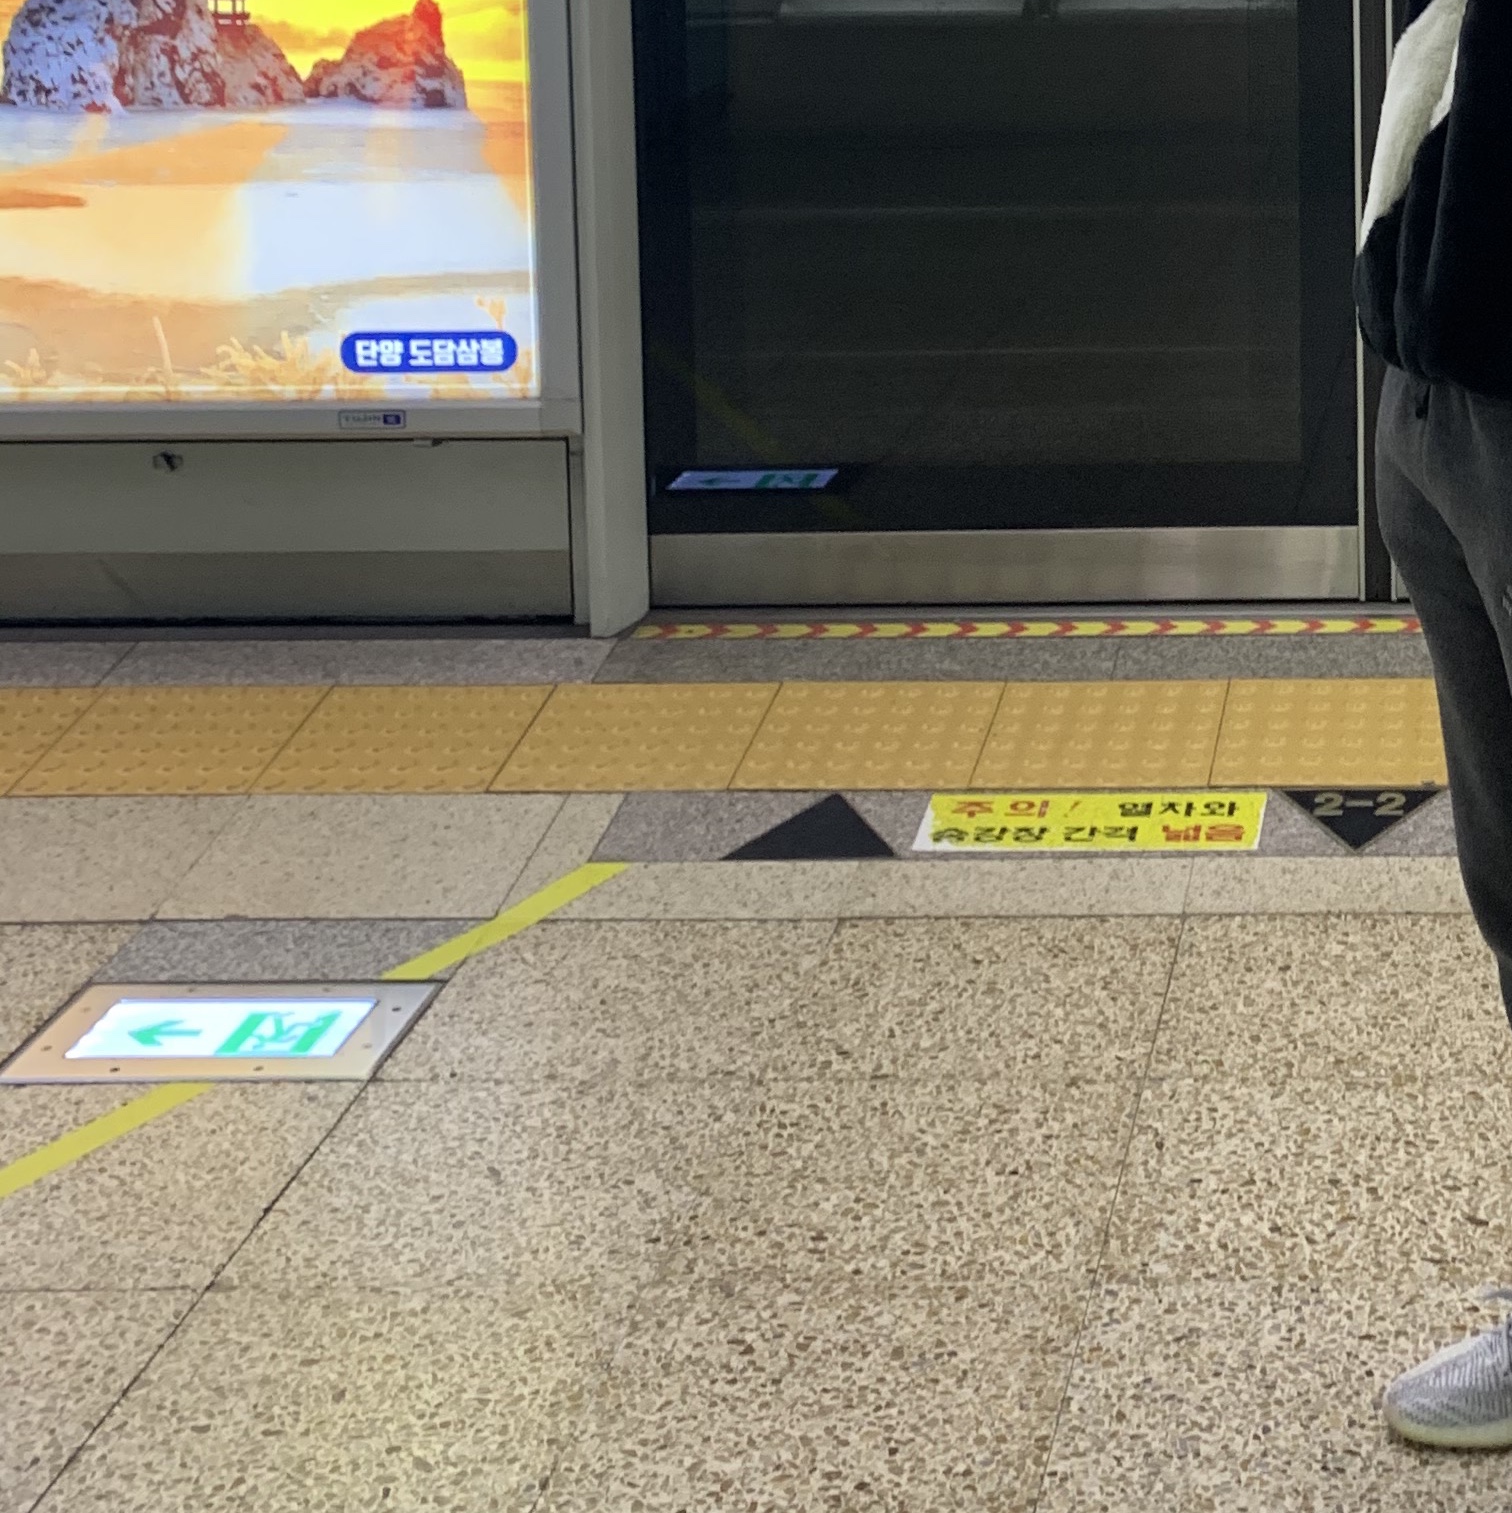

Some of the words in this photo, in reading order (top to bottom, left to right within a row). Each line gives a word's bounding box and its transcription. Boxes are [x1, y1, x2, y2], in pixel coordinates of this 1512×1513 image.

[355, 338, 404, 368] 단양
[408, 338, 505, 368] 도담삼봉
[1118, 800, 1239, 818] 열차와
[1312, 791, 1407, 818] 2-2
[1062, 826, 1140, 843] 간격
